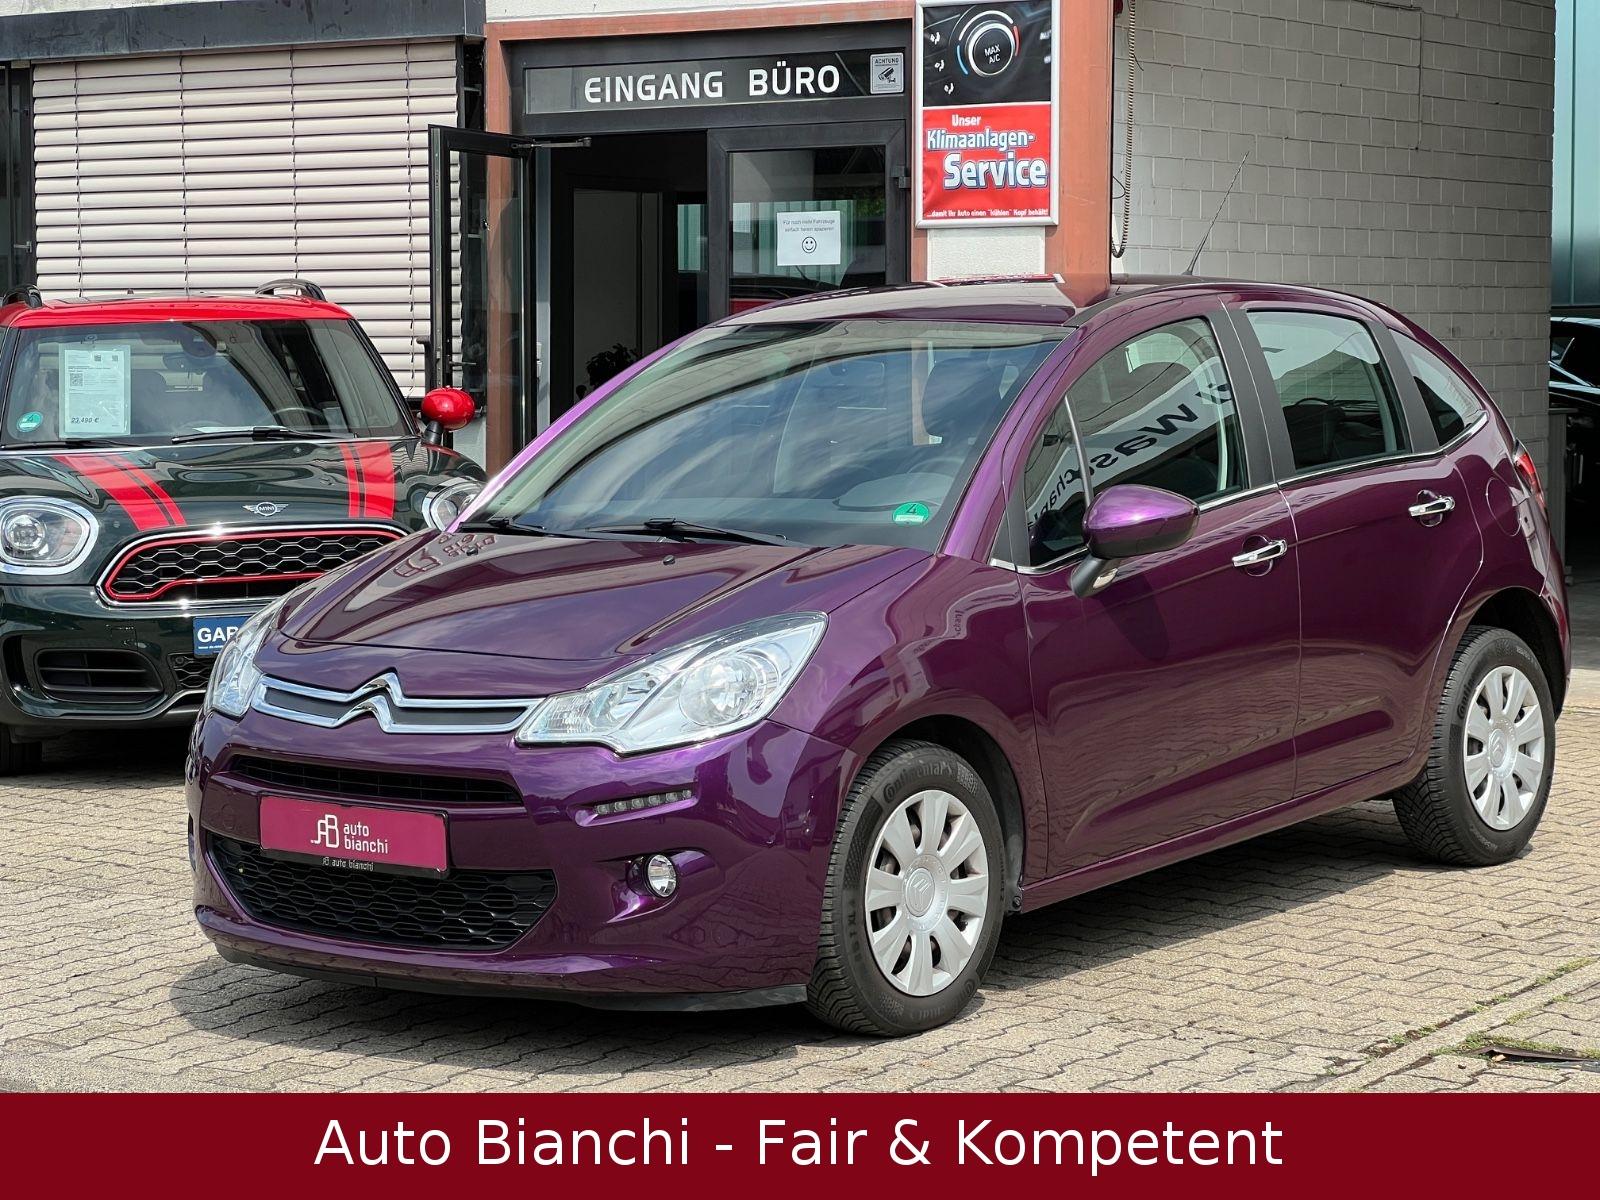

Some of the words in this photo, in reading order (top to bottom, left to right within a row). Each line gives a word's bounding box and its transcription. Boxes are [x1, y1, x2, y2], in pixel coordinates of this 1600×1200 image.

[984, 44, 1001, 57] MAX
[583, 70, 723, 104] EINGANG
[749, 60, 840, 97] BÜRO
[951, 114, 982, 127] Unser
[926, 127, 1036, 151] Klimaanlagen-
[943, 151, 1049, 190] Service
[957, 209, 971, 217] Auto
[971, 209, 987, 217] einen
[1013, 208, 1027, 218] Kopf
[906, 503, 917, 514] 4
[343, 821, 370, 836] auto
[344, 835, 388, 854] bianchi
[332, 859, 347, 868] auto
[348, 859, 374, 871] bianchi
